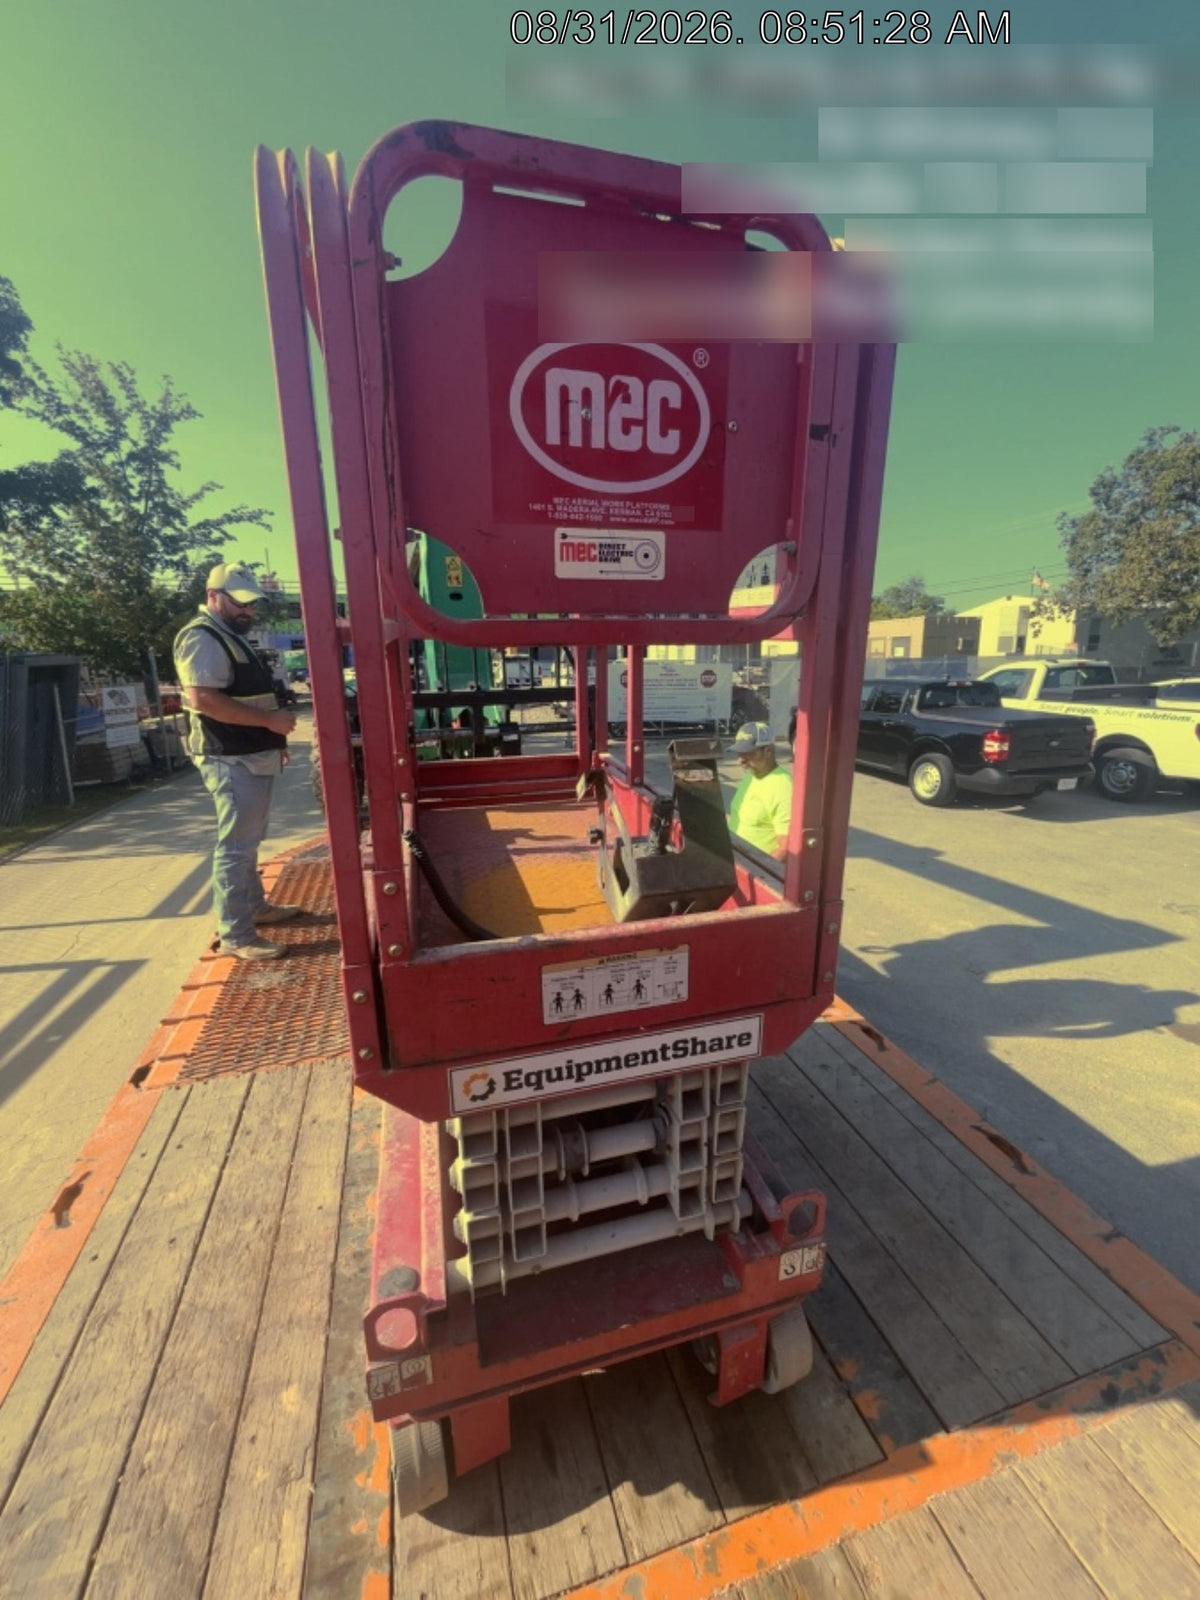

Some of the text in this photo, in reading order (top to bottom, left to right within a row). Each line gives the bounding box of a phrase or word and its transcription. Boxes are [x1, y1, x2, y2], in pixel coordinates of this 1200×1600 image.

[572, 497, 599, 506] AERIAL
[625, 500, 670, 511] PLATFORMS
[599, 556, 621, 564] DRIVE
[502, 1031, 752, 1090] EquipmentShare
